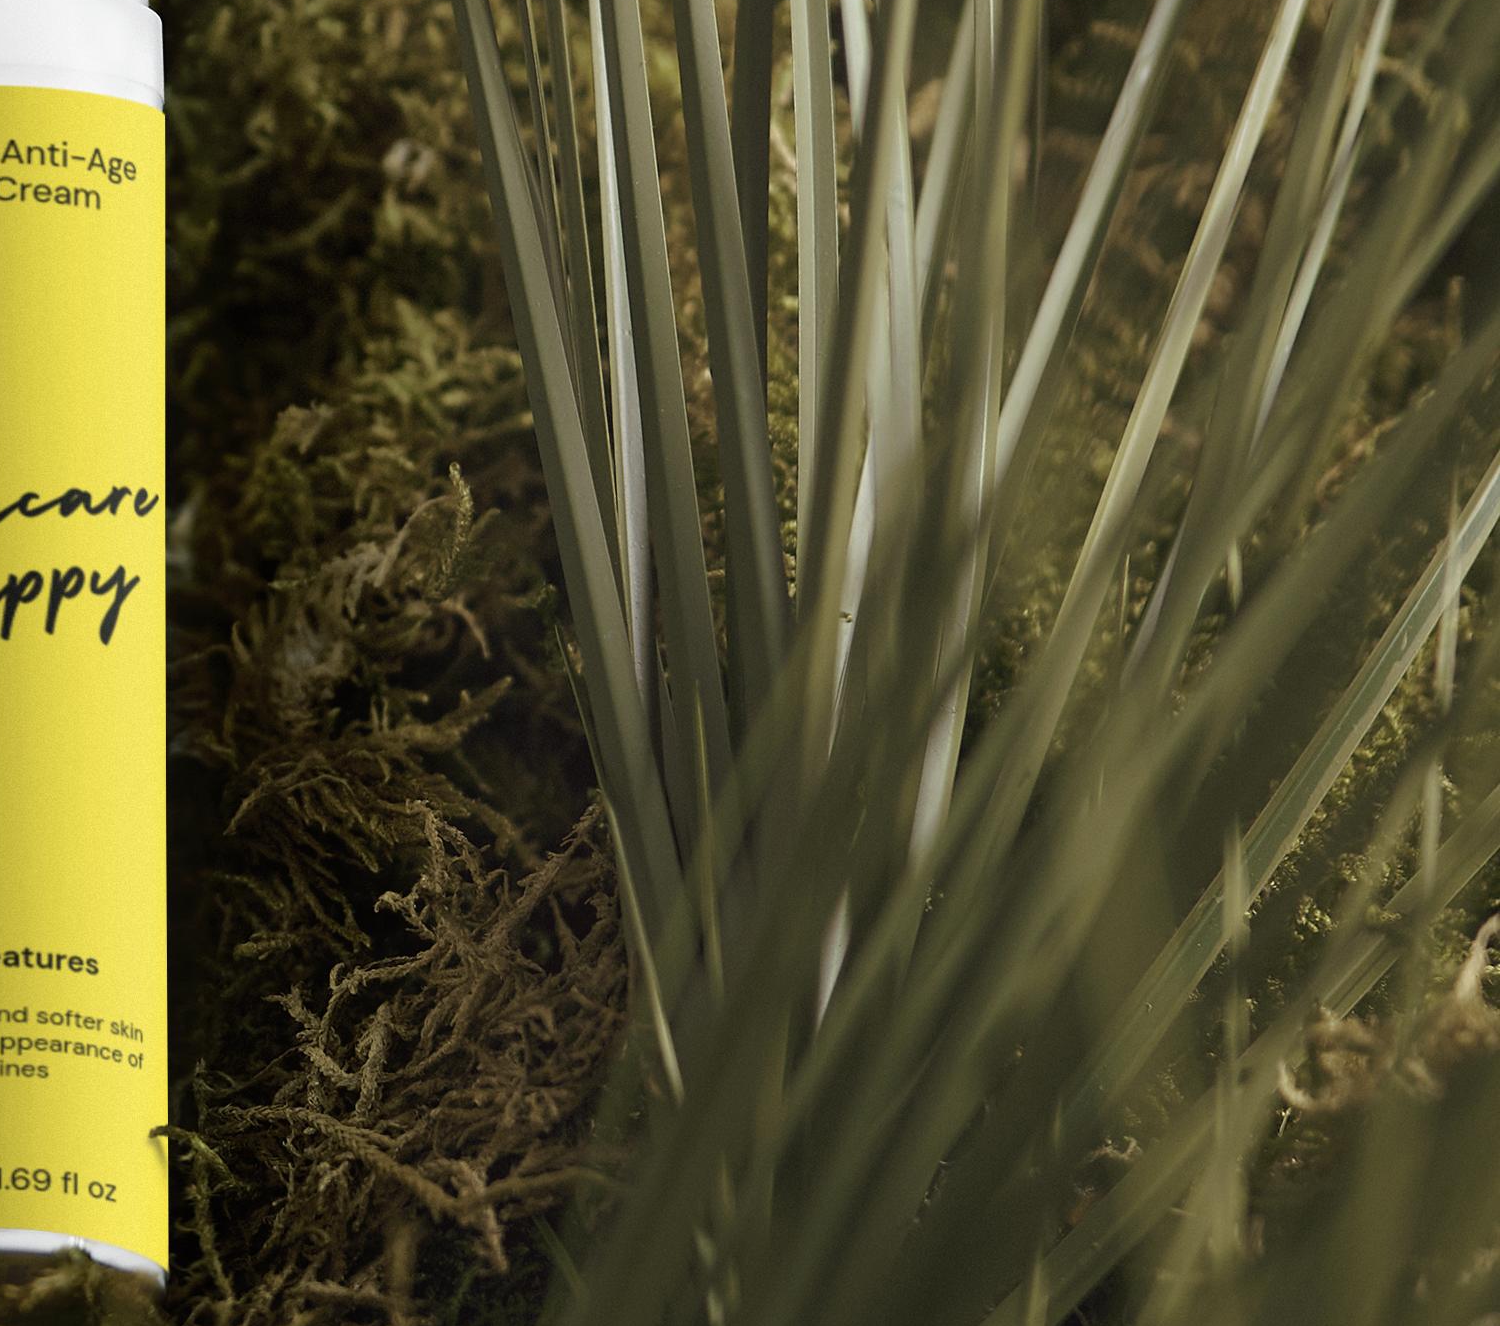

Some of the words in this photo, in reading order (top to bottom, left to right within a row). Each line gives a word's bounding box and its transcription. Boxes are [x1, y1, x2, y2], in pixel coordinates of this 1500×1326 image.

[0, 139, 137, 184] Anti-Age
[36, 1009, 104, 1031] softer
[110, 1019, 144, 1043] skin
[128, 1053, 144, 1070] of
[62, 1171, 79, 1195] fl
[88, 1181, 117, 1203] oz
